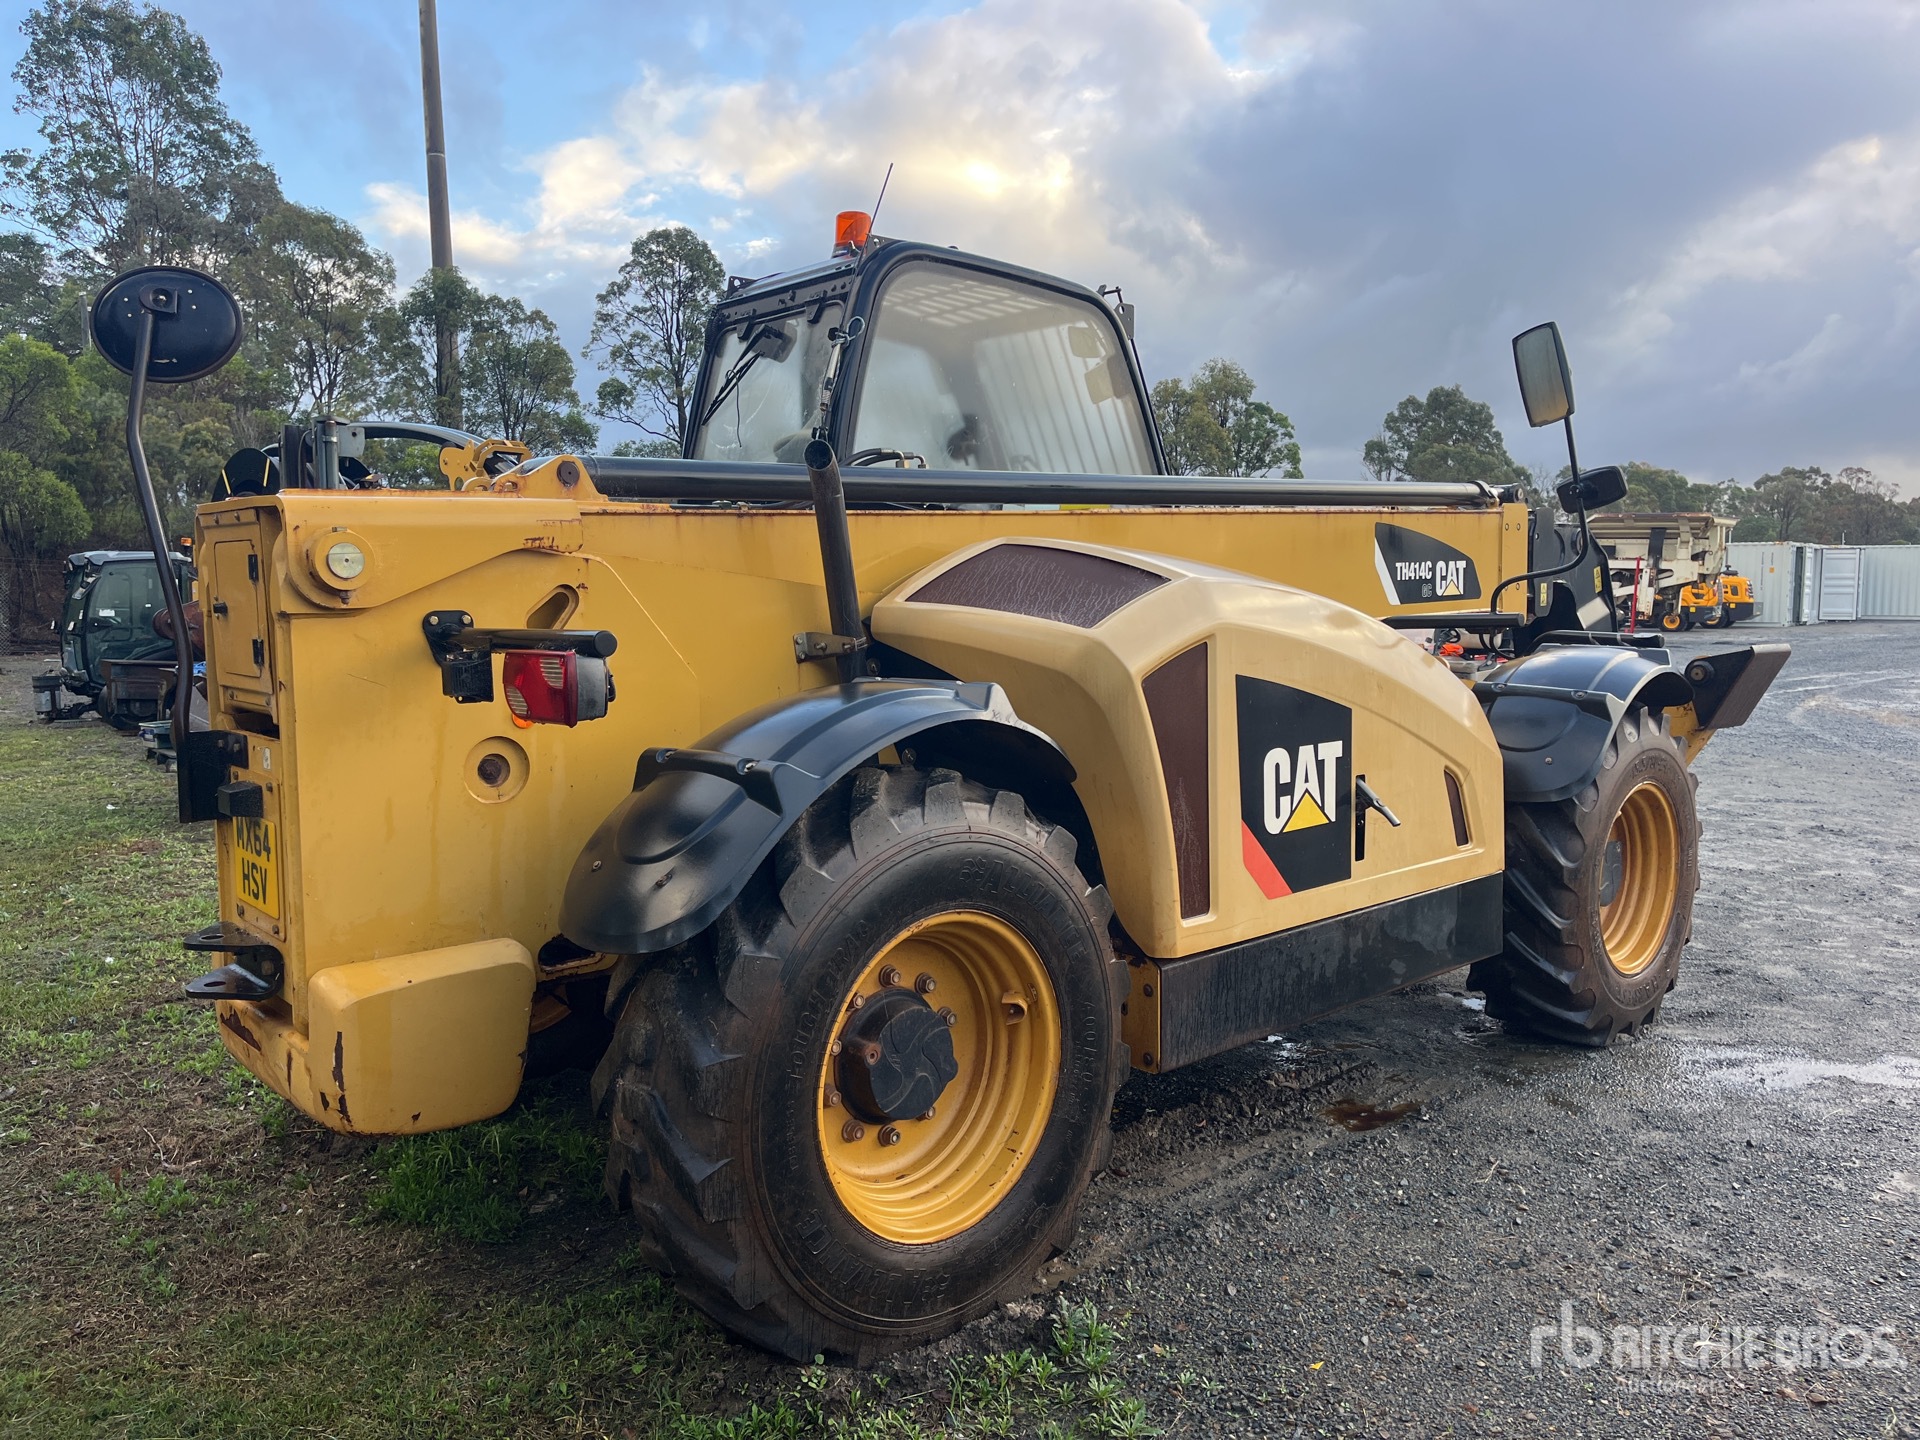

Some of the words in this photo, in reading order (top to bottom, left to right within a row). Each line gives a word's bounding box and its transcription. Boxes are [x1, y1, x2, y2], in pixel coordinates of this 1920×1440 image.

[1395, 561, 1432, 581] TH414C
[1436, 560, 1467, 597] CAT
[1263, 740, 1343, 835] CAT
[237, 817, 271, 862] MX64
[242, 858, 268, 905] HSV
[979, 860, 1088, 964] ALLIANCE
[794, 1208, 927, 1304] ALLIANCE
